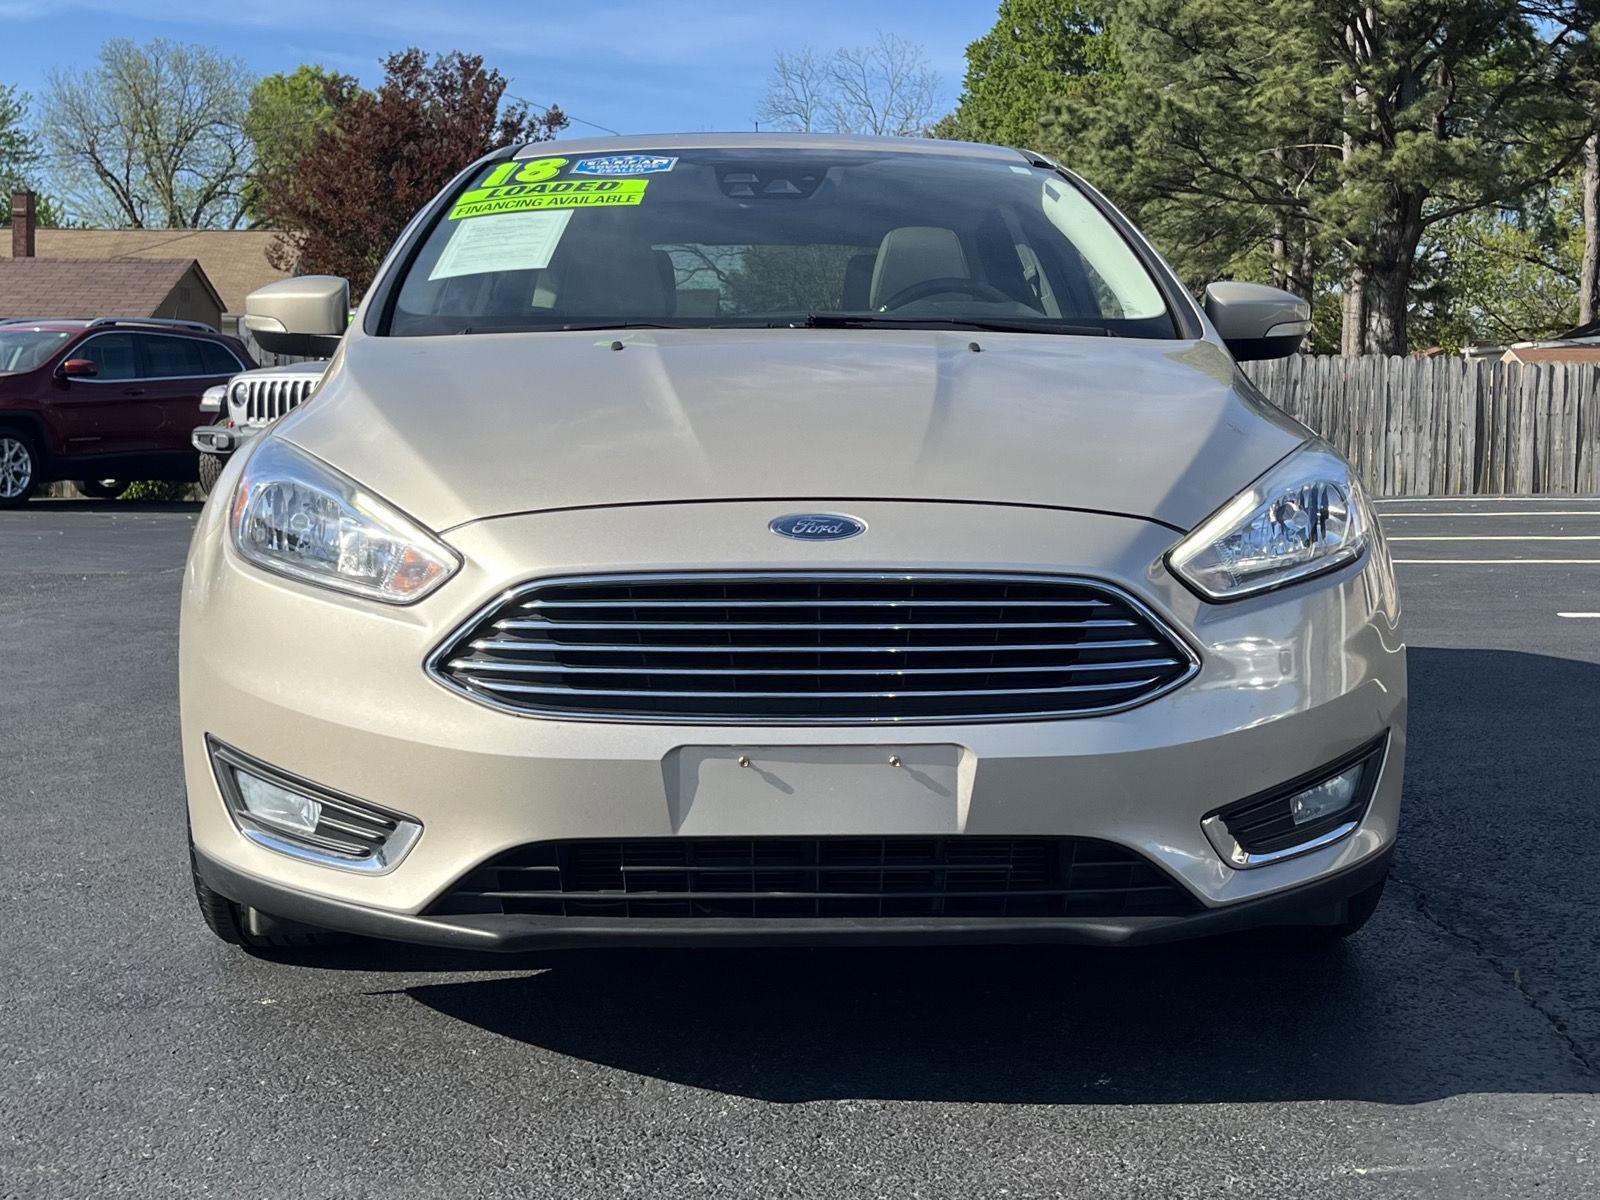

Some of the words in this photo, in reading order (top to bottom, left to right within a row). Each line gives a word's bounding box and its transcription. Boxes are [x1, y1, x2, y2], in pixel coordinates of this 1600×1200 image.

[481, 158, 569, 187] 18
[486, 181, 621, 199] LOADED
[456, 198, 543, 216] FINANCING
[547, 194, 637, 206] AVAILABLE
[791, 519, 843, 534] Ford
